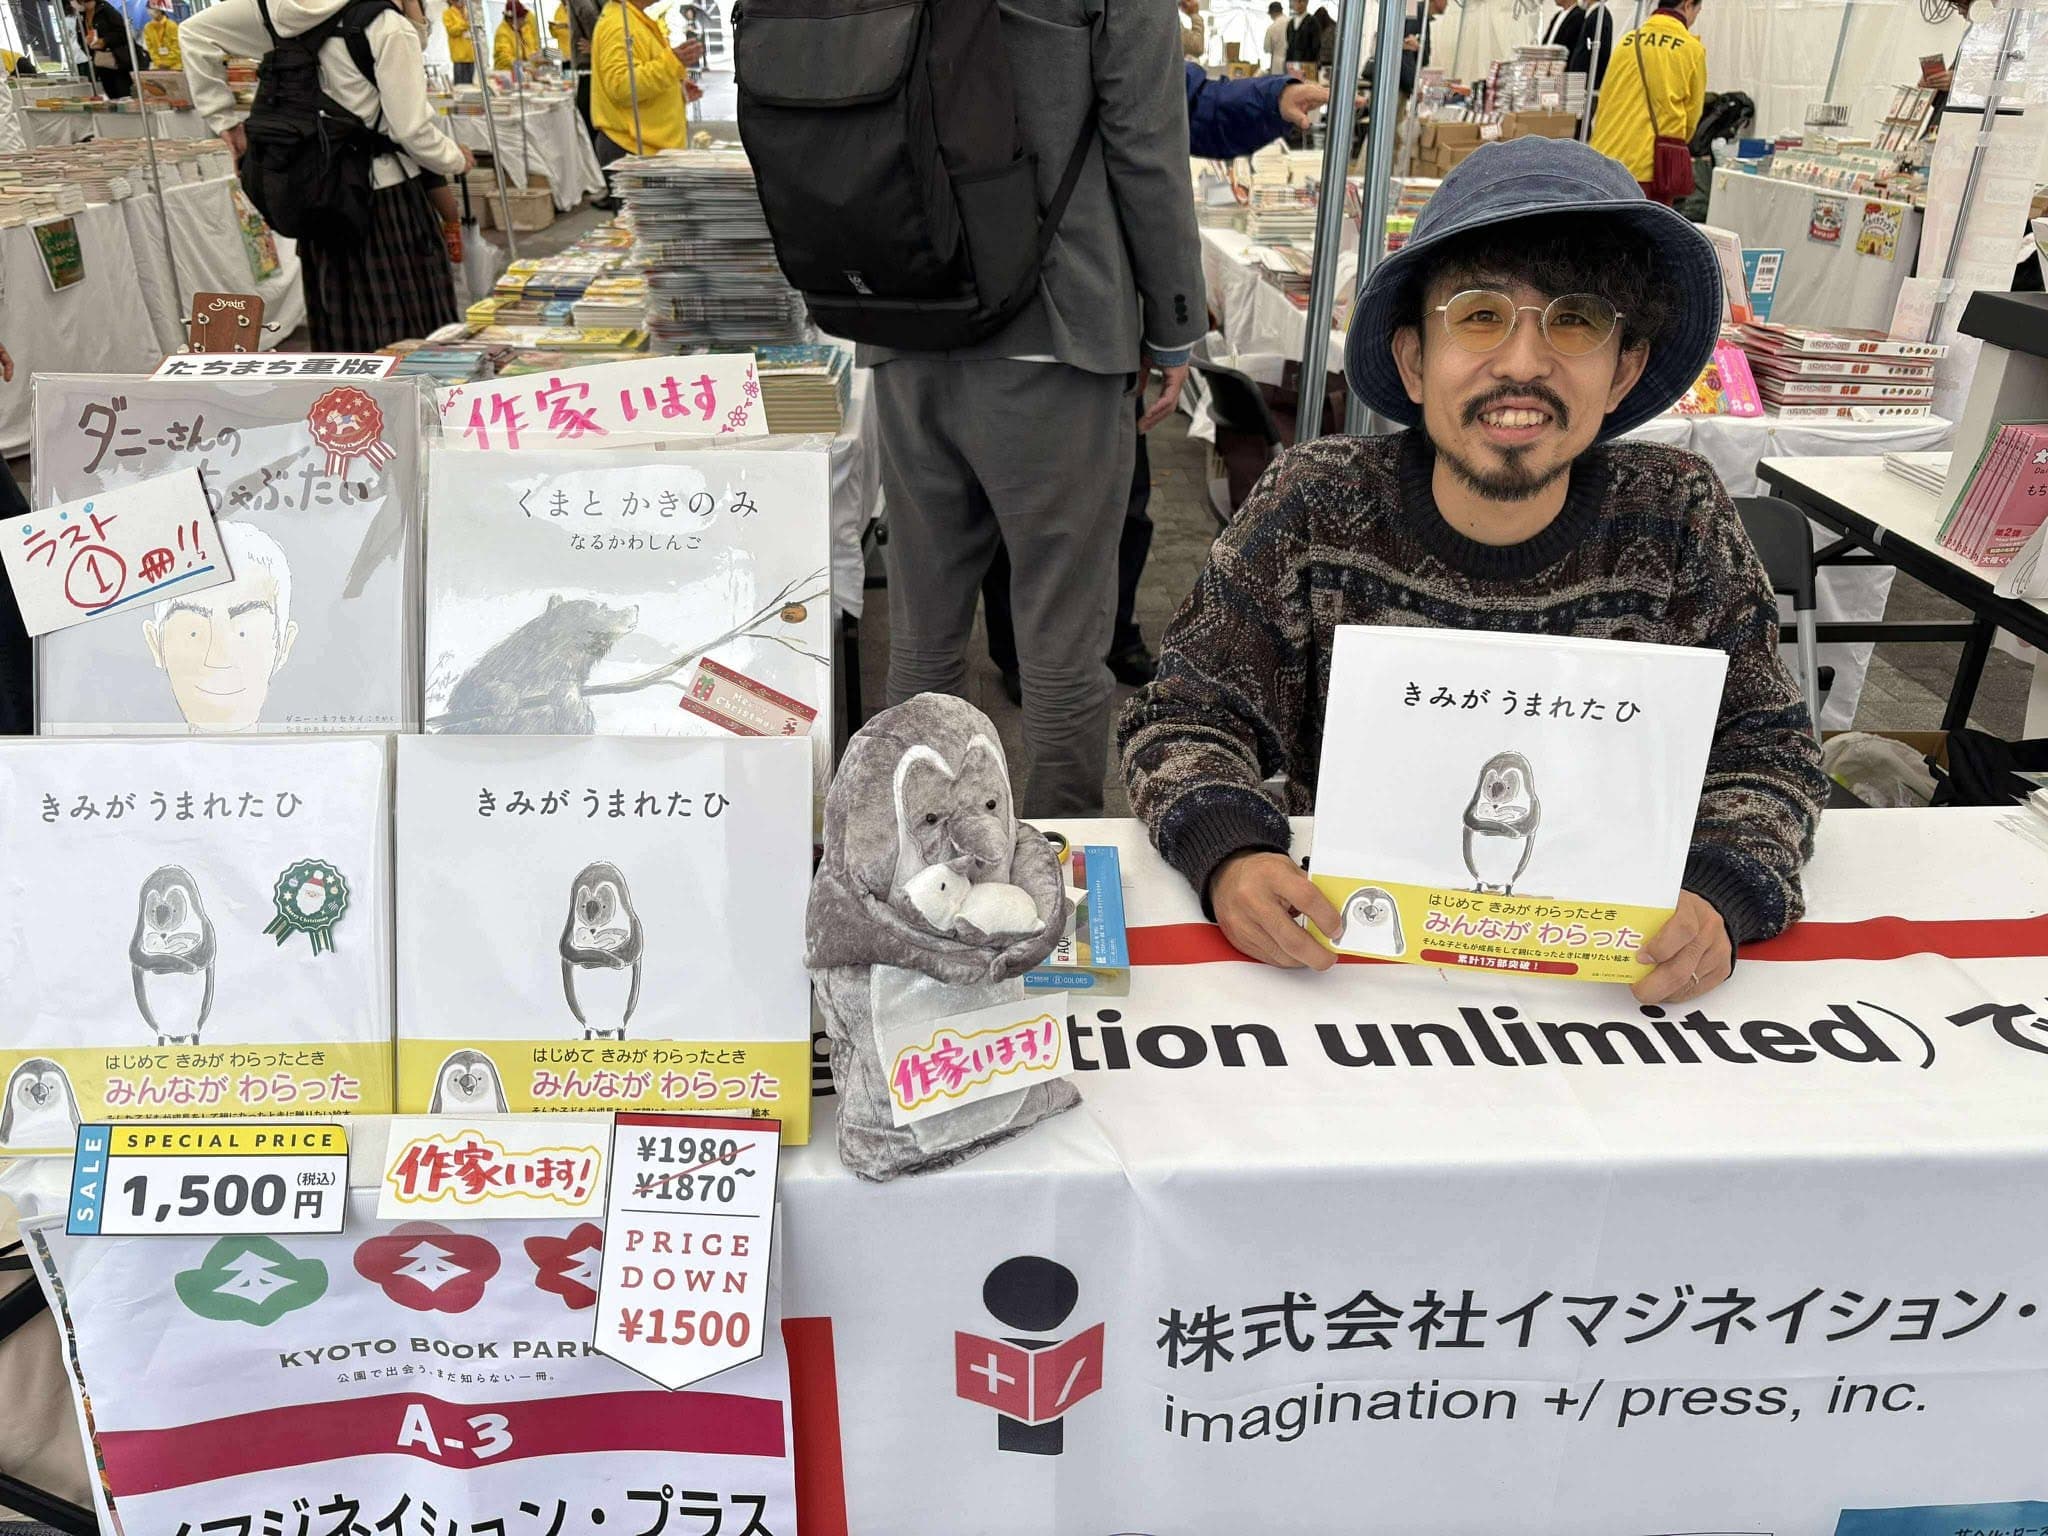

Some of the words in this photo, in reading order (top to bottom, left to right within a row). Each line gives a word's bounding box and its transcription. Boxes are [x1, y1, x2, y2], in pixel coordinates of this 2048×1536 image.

[164, 358, 384, 376] たちまち重版
[463, 377, 610, 450] 作家
[620, 375, 718, 422] います
[78, 396, 241, 474] ダニーさんの
[23, 513, 117, 567] ラスト
[570, 534, 702, 551] なるかわしんご
[1425, 911, 1531, 941] みんなが
[1539, 923, 1642, 949] わらった
[106, 1074, 229, 1105] みんなが
[239, 1073, 359, 1103] わらった
[532, 1070, 651, 1098] みんなが
[661, 1071, 778, 1098] わらった
[127, 1134, 239, 1148] SPECIAL
[255, 1133, 333, 1147] PRICE
[637, 1135, 738, 1167] ¥1980
[77, 1138, 102, 1222] SALE
[625, 1230, 750, 1257] PRICE
[620, 1266, 748, 1294] DOWN
[618, 1308, 751, 1348] ¥1500
[279, 1338, 397, 1368] KYOTO
[410, 1337, 499, 1359] BOOK
[1164, 1379, 1517, 1443] imagination
[1618, 1386, 1801, 1428] press,
[1827, 1376, 1926, 1414] inc.
[397, 1404, 514, 1459] A-3
